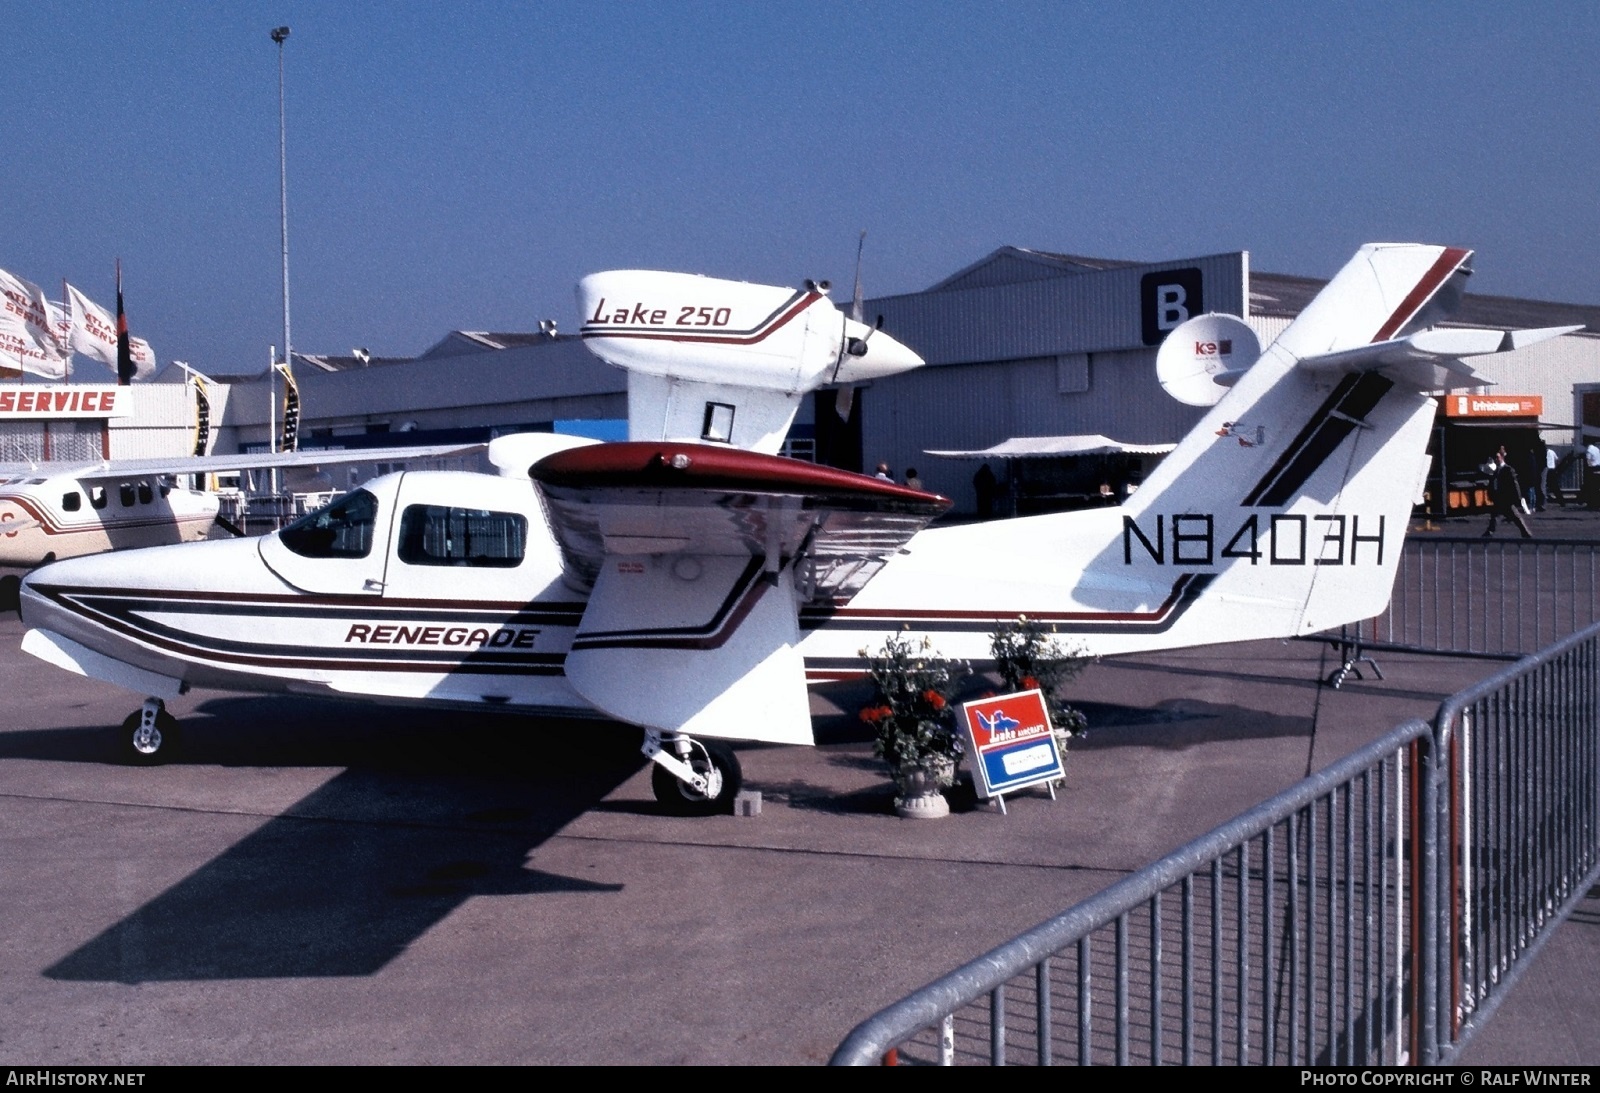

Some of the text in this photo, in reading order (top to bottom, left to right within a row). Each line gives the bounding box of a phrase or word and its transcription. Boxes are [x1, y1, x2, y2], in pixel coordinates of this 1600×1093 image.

[586, 298, 732, 326] Lake 250
[1157, 284, 1189, 331] B
[0, 392, 116, 412] SERVICE
[1122, 514, 1386, 566] N8403H
[344, 623, 541, 649] RENEGADE
[989, 714, 1016, 744] Lake
